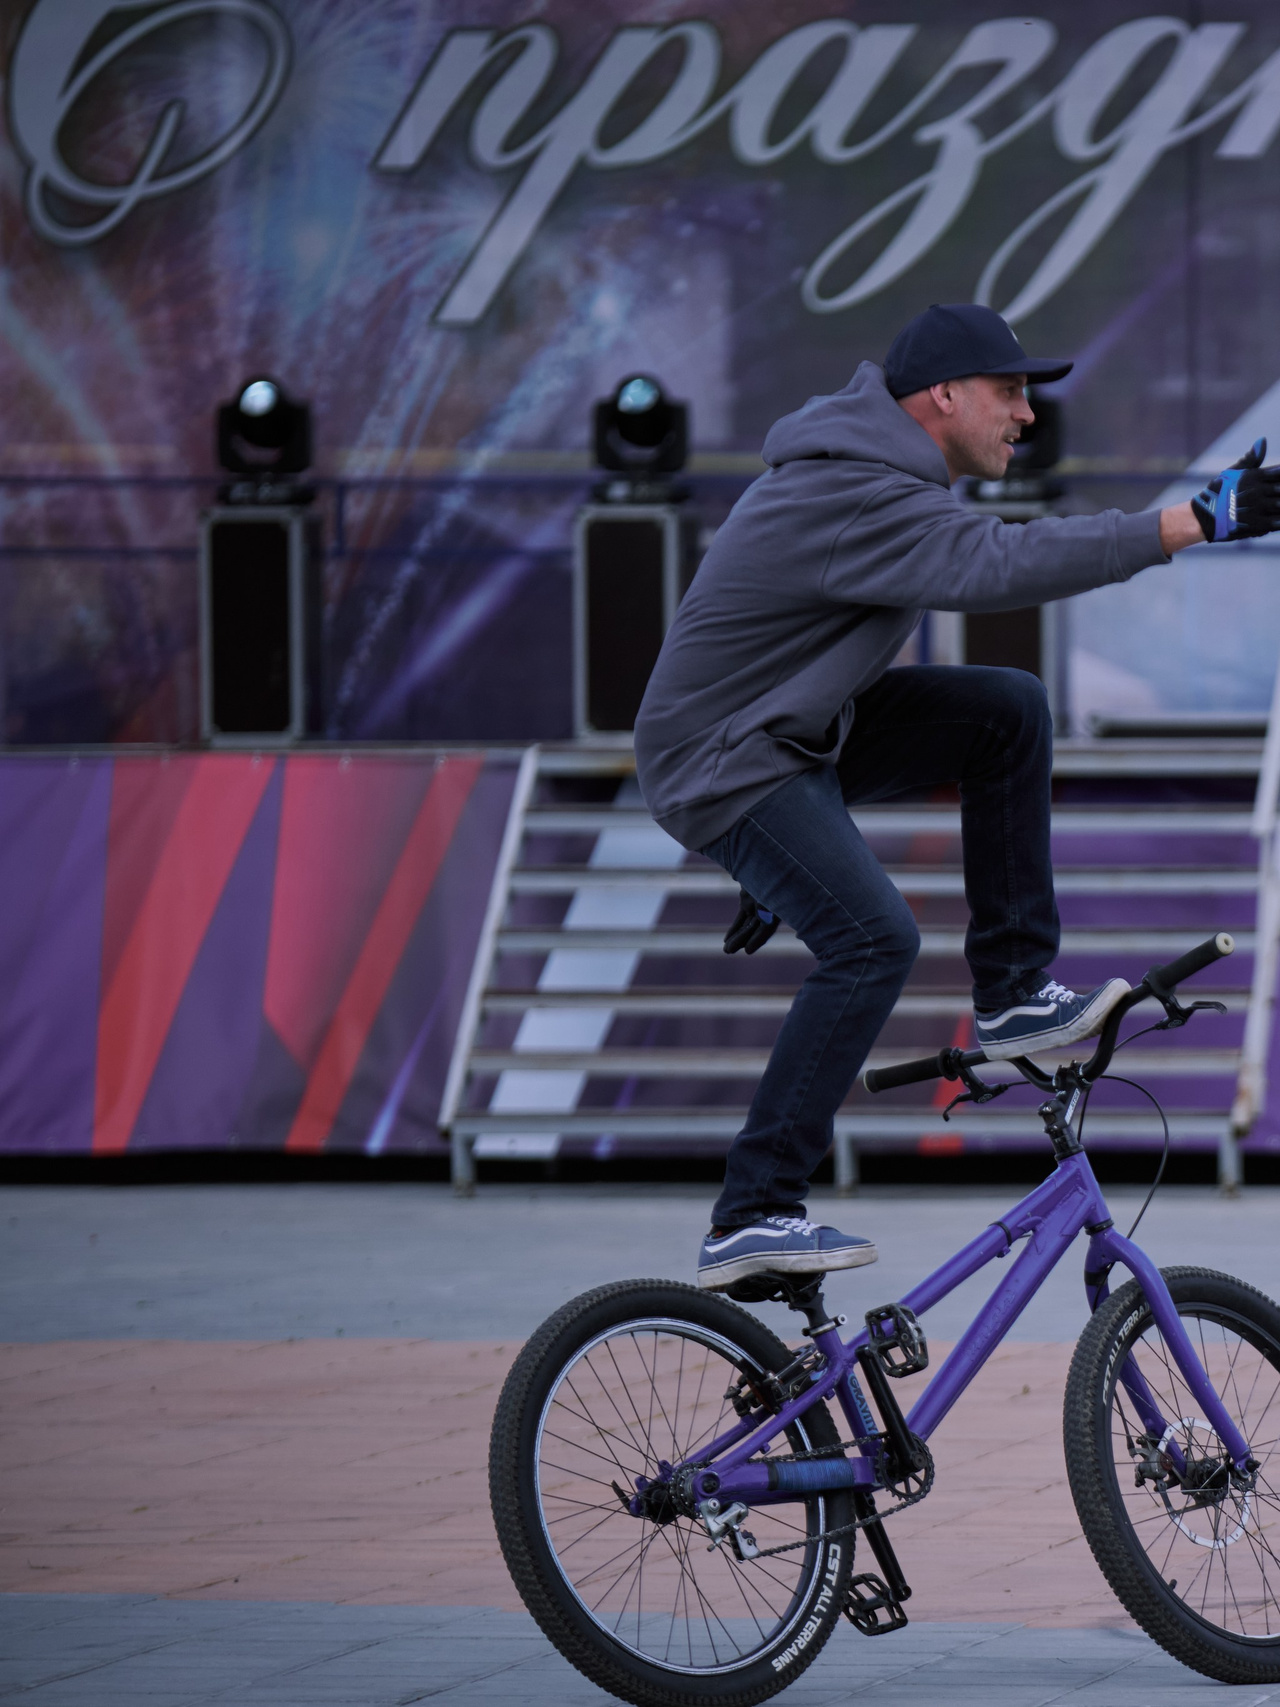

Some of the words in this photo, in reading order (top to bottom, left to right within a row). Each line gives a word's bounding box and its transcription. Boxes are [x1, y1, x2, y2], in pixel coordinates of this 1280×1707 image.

[1109, 1340, 1121, 1367] ALL
[1118, 1302, 1150, 1341] TERRAI
[849, 1374, 878, 1432] GRAVITY
[825, 1543, 841, 1586] CST
[814, 1584, 833, 1612] ALL
[771, 1615, 822, 1672] TERRAINS
